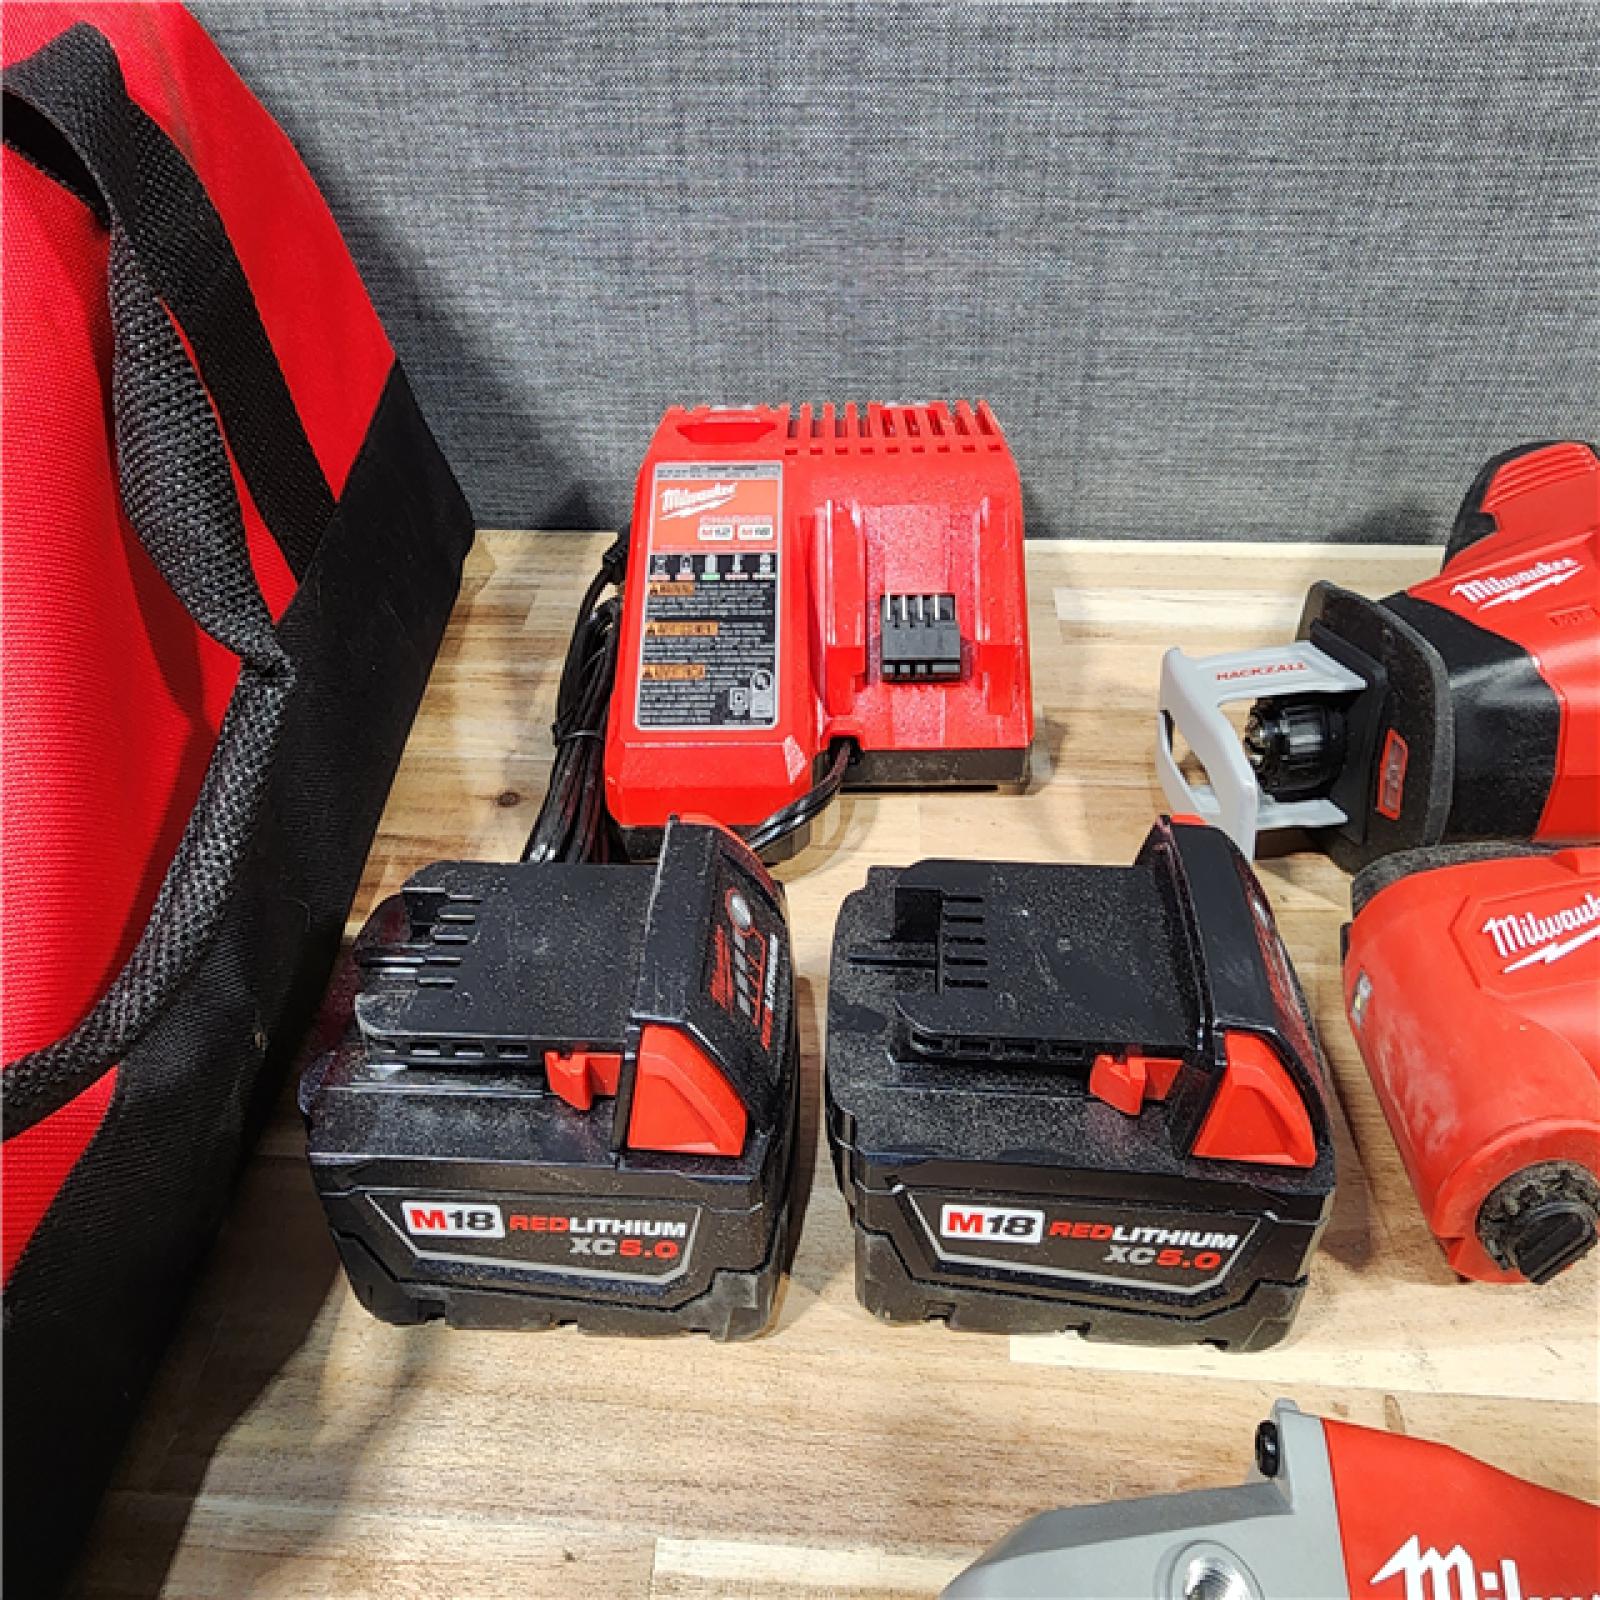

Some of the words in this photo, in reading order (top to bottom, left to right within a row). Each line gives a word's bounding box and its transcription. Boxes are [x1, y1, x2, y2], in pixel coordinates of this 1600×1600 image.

[1450, 557, 1579, 604] Milwaukee
[1216, 661, 1307, 680] HACKZALL
[1482, 892, 1600, 958] Milwauk
[409, 1208, 496, 1232] M18
[509, 1214, 686, 1237] REDLITHIUM
[947, 1211, 1037, 1236] M18
[1048, 1220, 1240, 1249] REDLITHIUM
[569, 1238, 680, 1259] XC5.0
[1103, 1245, 1222, 1271] XC5.0
